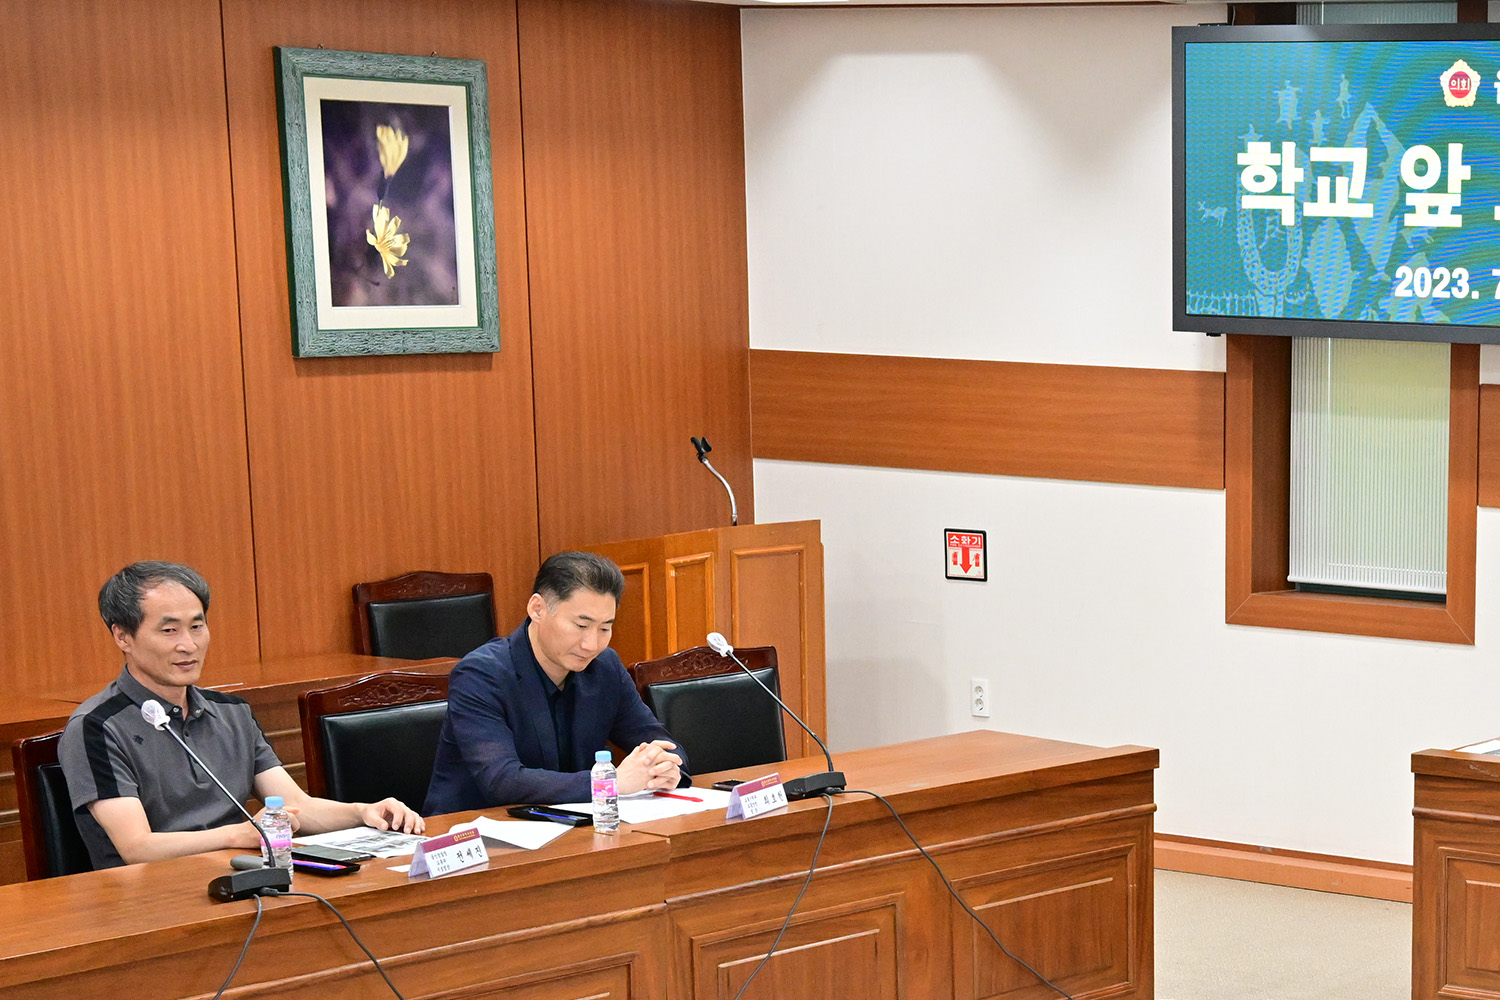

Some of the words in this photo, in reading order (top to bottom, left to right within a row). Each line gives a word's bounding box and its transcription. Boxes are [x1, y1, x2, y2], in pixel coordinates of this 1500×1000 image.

[1450, 78, 1470, 91] 의회
[1237, 141, 1374, 226] 학교
[1400, 142, 1471, 228] 앞
[1394, 265, 1480, 300] 2023.
[950, 535, 981, 545] 소화기
